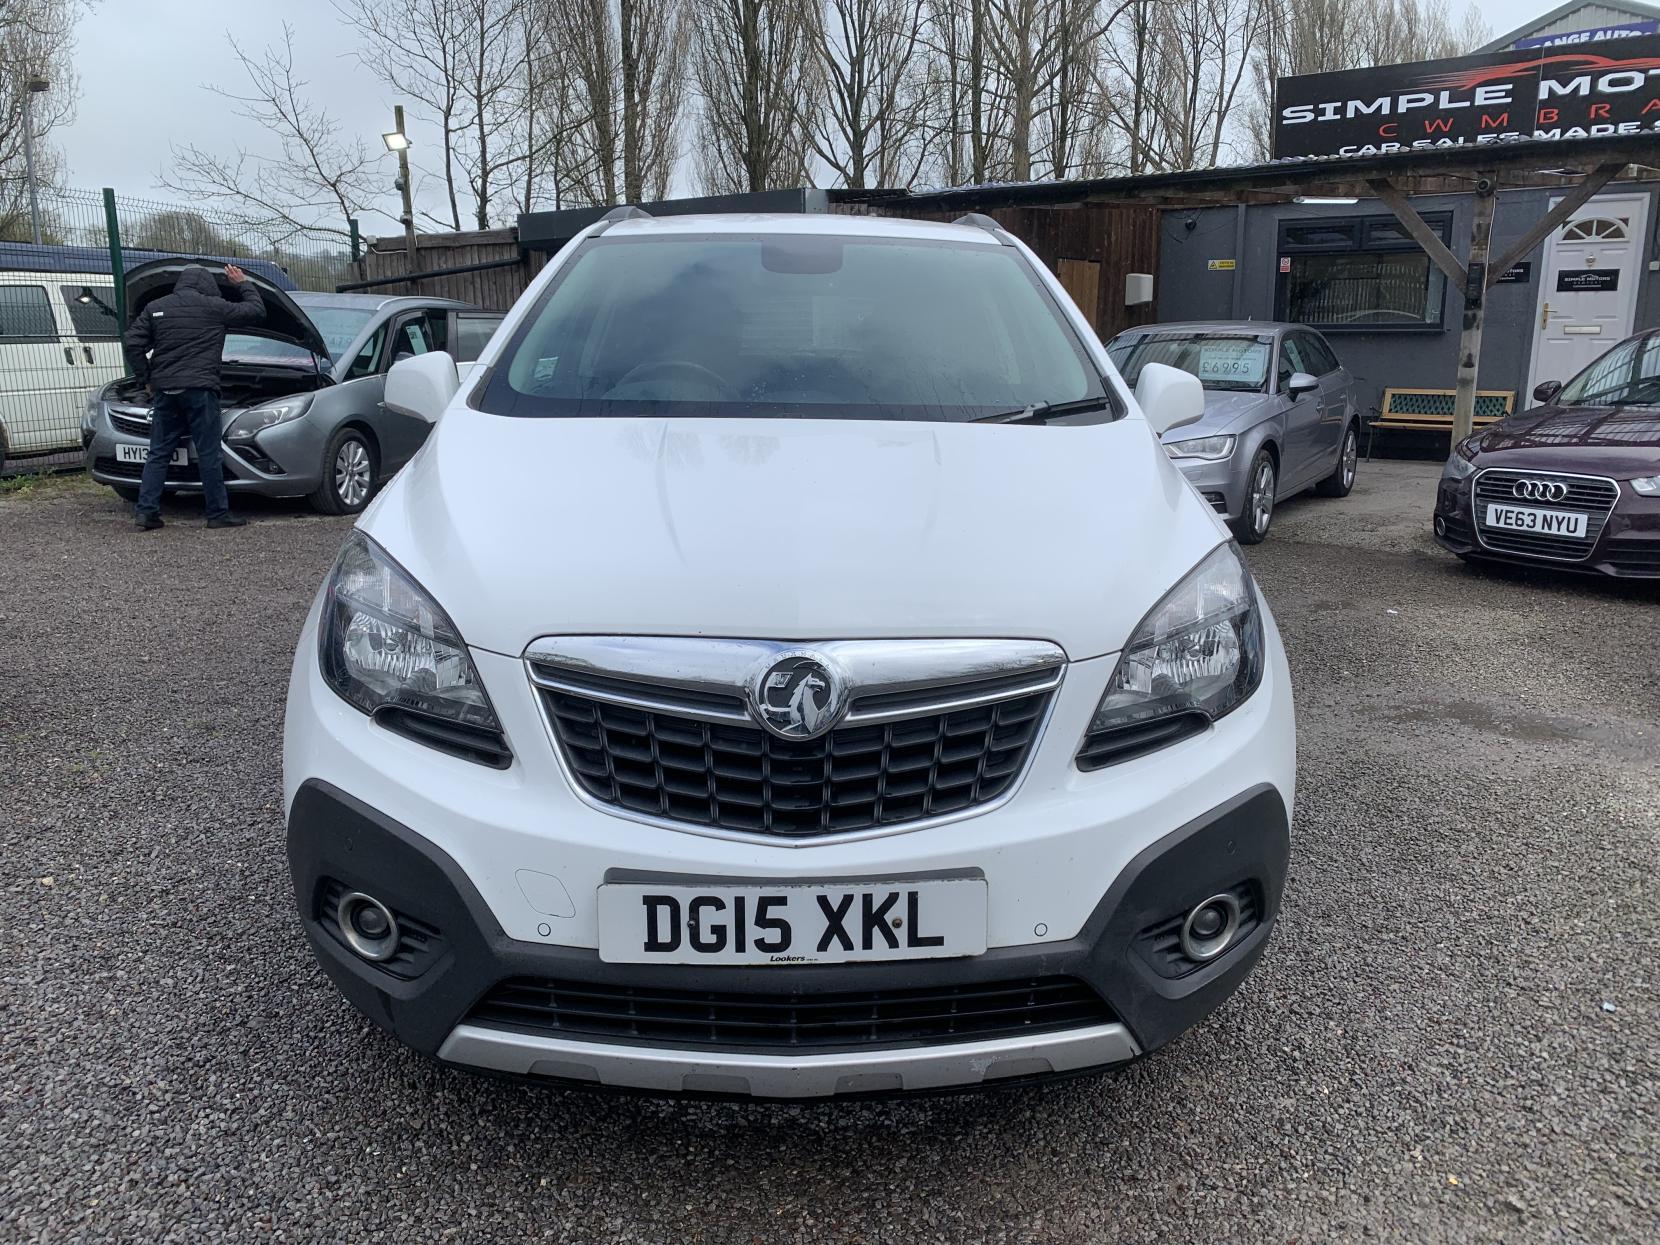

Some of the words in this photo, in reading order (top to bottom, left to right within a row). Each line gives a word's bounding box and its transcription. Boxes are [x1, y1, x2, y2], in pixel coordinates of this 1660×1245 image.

[1282, 83, 1513, 124] SIMPLE
[1339, 142, 1401, 156] CAR
[1412, 131, 1520, 147] SALES
[1534, 121, 1641, 140] MADE
[1202, 361, 1250, 374] £6995
[1494, 508, 1537, 529] VE63
[1541, 513, 1579, 534] NYU
[642, 895, 792, 953] DG15
[816, 891, 945, 952] XKL
